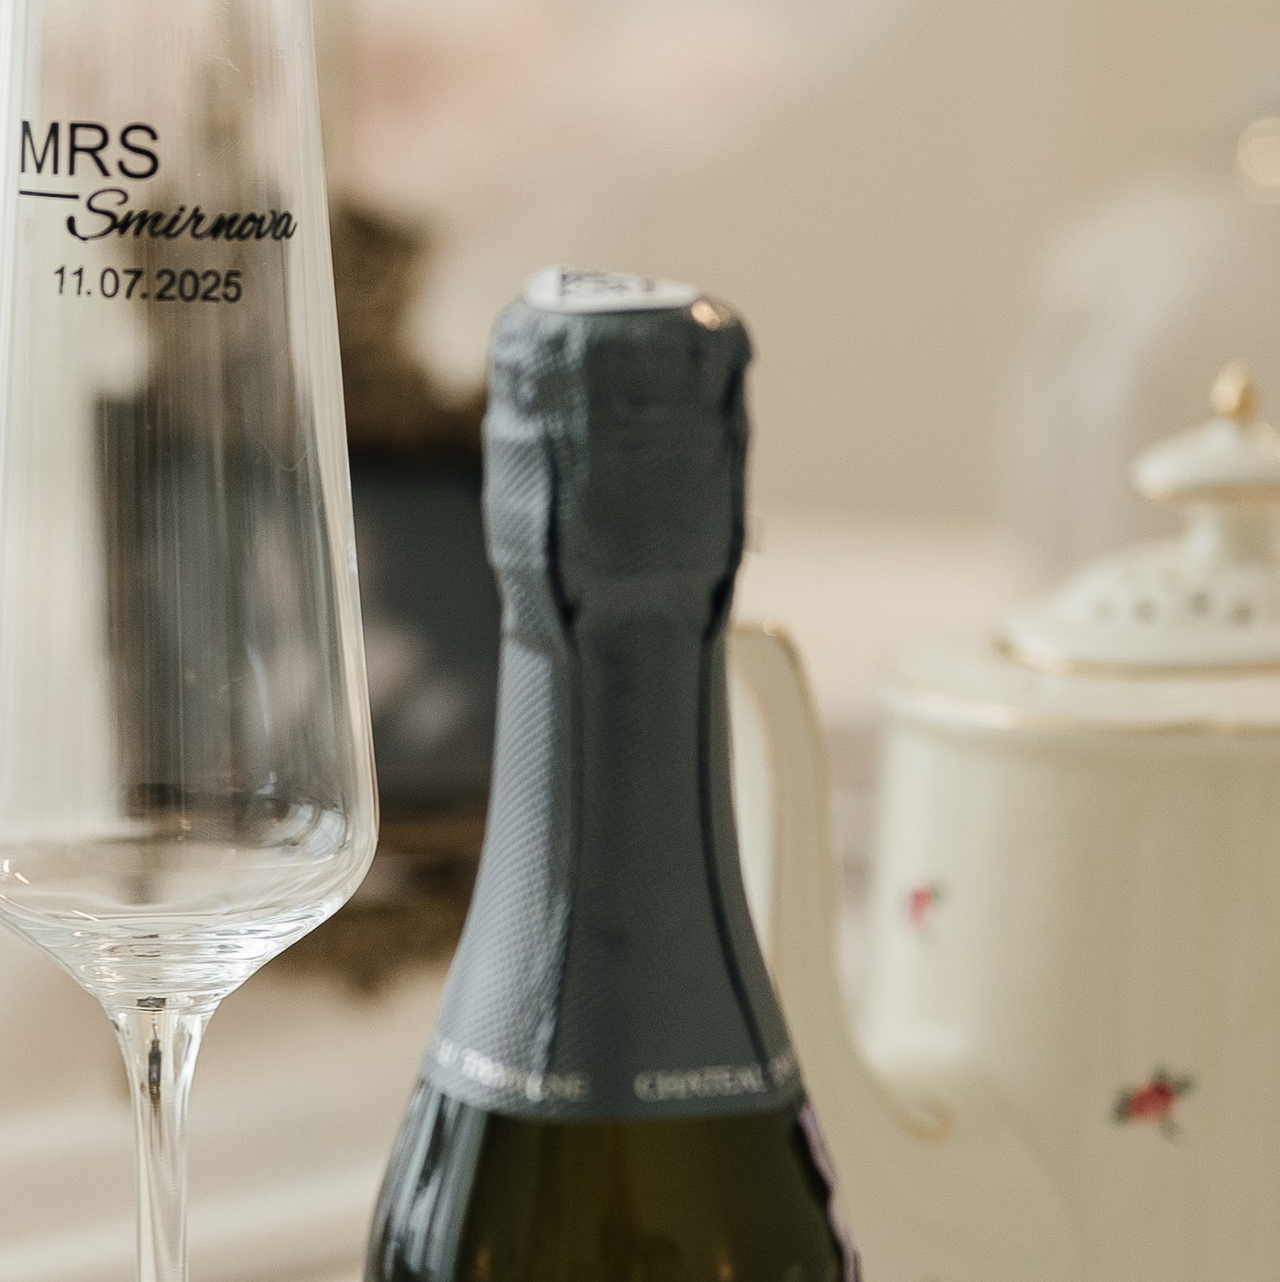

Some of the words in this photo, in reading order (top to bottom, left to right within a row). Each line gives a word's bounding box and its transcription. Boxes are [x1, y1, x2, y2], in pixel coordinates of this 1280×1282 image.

[20, 120, 160, 179] MRS
[66, 188, 298, 241] Smirnova
[53, 265, 243, 303] 11.07.2025
